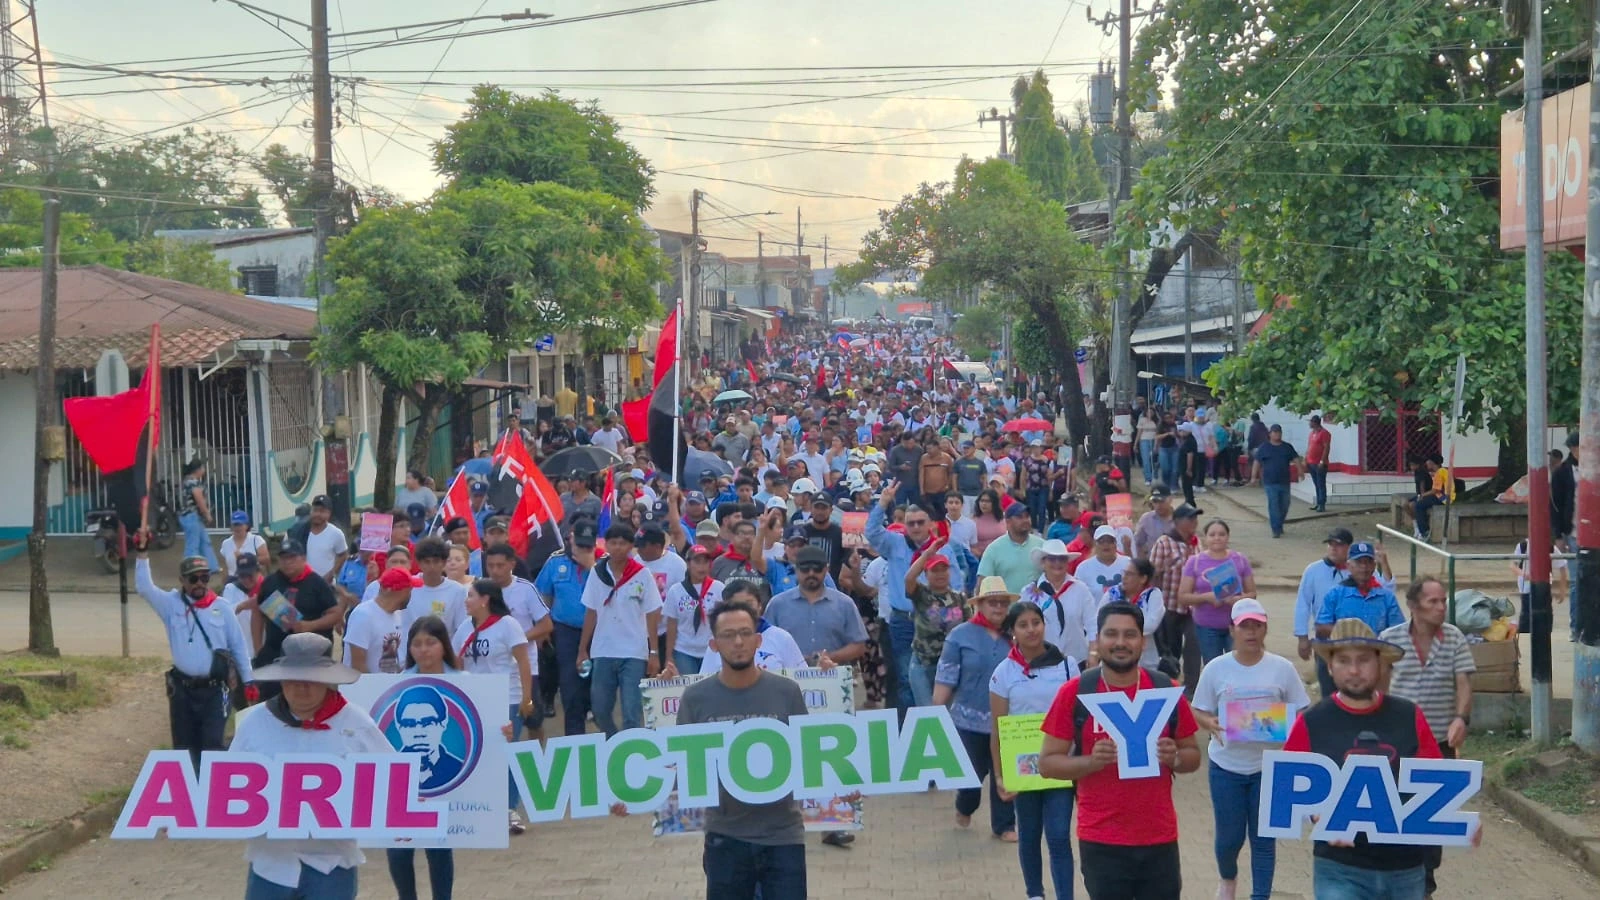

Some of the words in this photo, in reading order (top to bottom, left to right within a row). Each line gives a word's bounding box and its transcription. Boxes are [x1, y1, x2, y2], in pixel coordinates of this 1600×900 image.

[1513, 137, 1582, 207] TDO
[516, 719, 964, 810] VICTORIA
[1097, 698, 1168, 768] Y
[130, 762, 437, 828] ABRIL
[1269, 761, 1471, 836] PAZ
